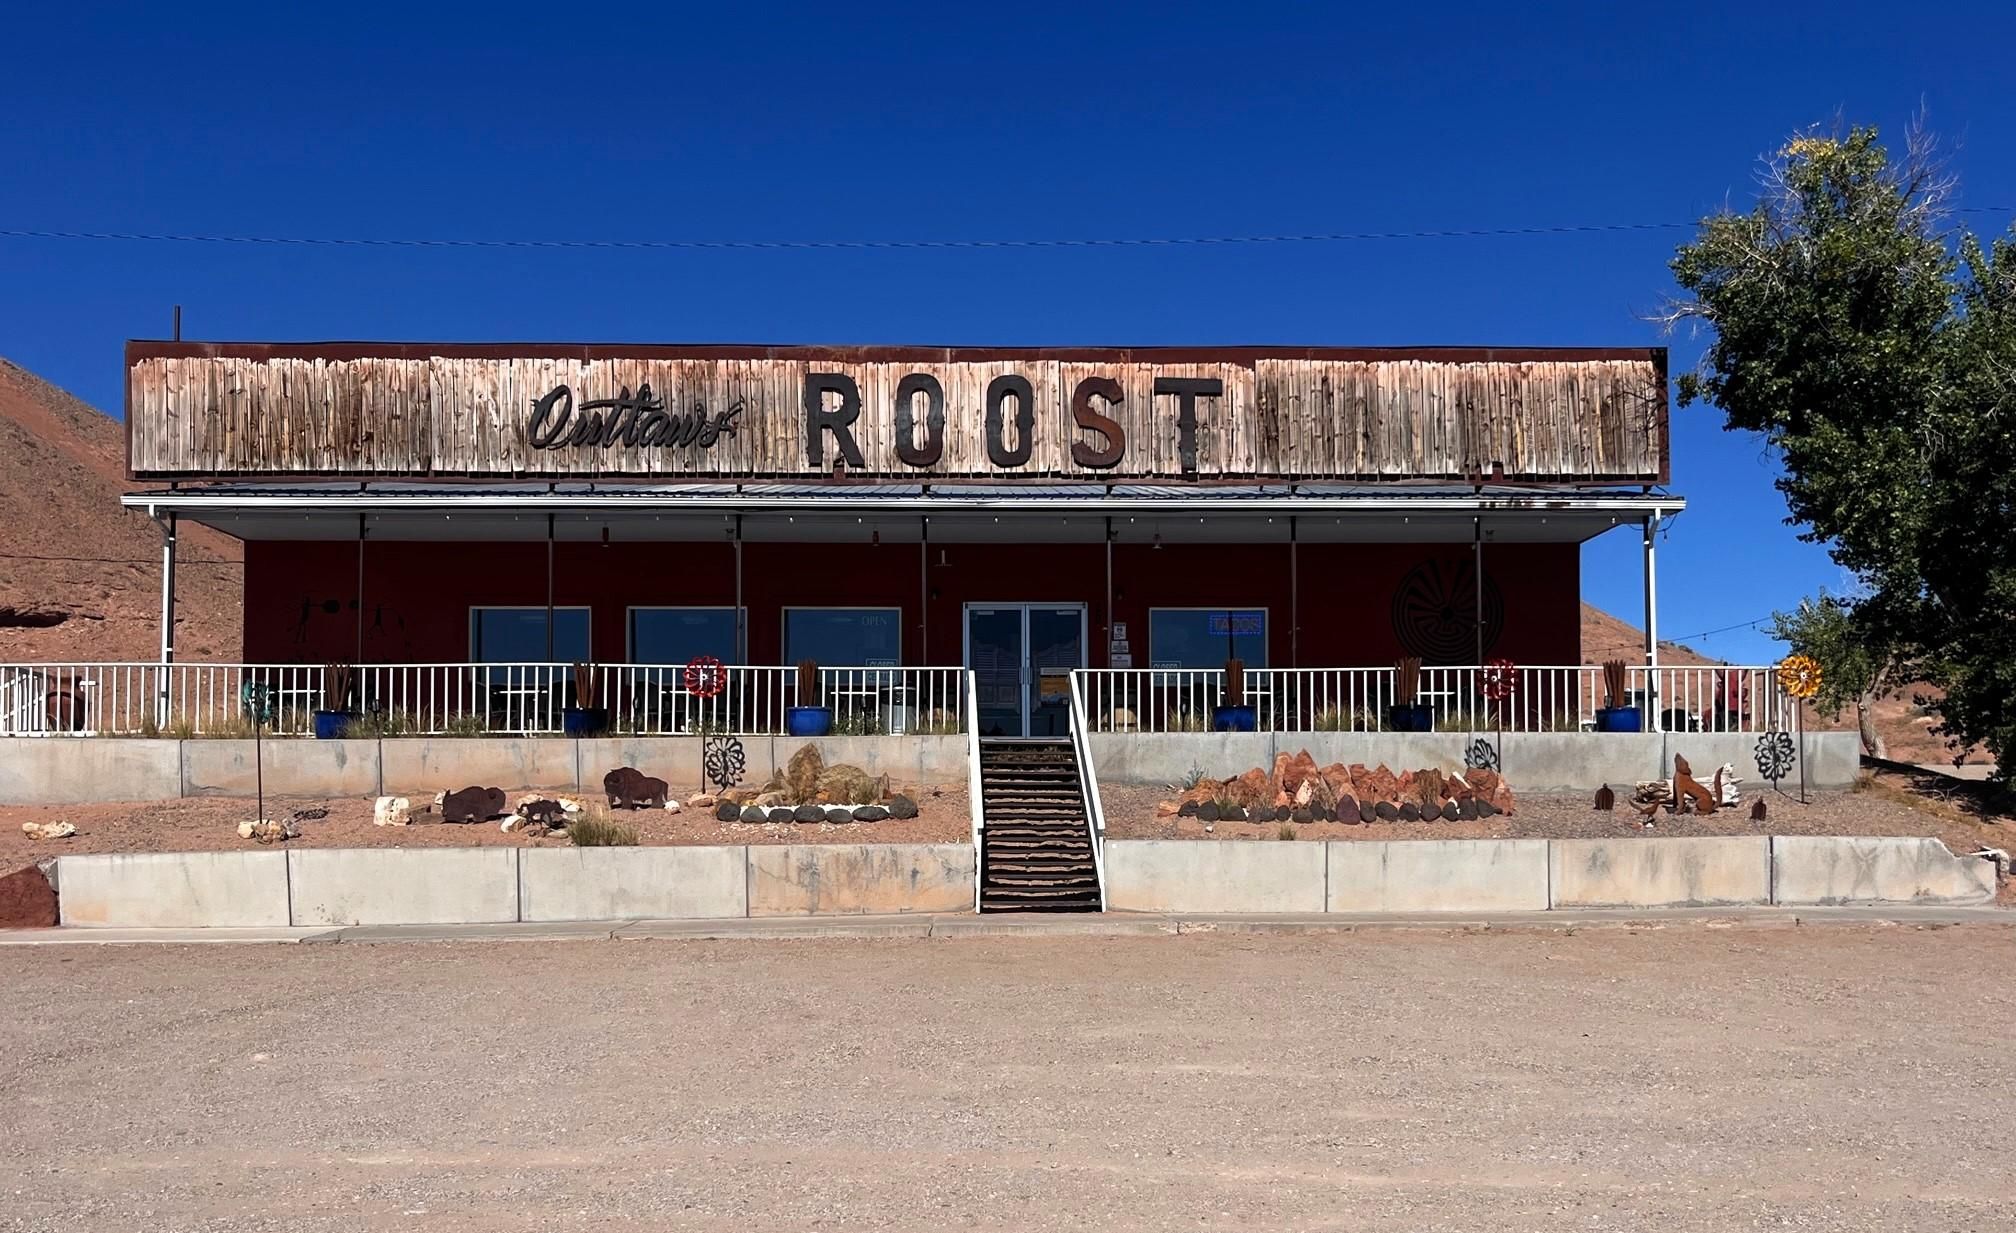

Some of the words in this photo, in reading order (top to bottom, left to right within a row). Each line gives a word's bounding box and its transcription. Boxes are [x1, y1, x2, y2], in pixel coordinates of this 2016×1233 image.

[805, 373, 1223, 471] ROOST
[862, 615, 888, 626] OPEN
[1216, 618, 1258, 631] TACOS
